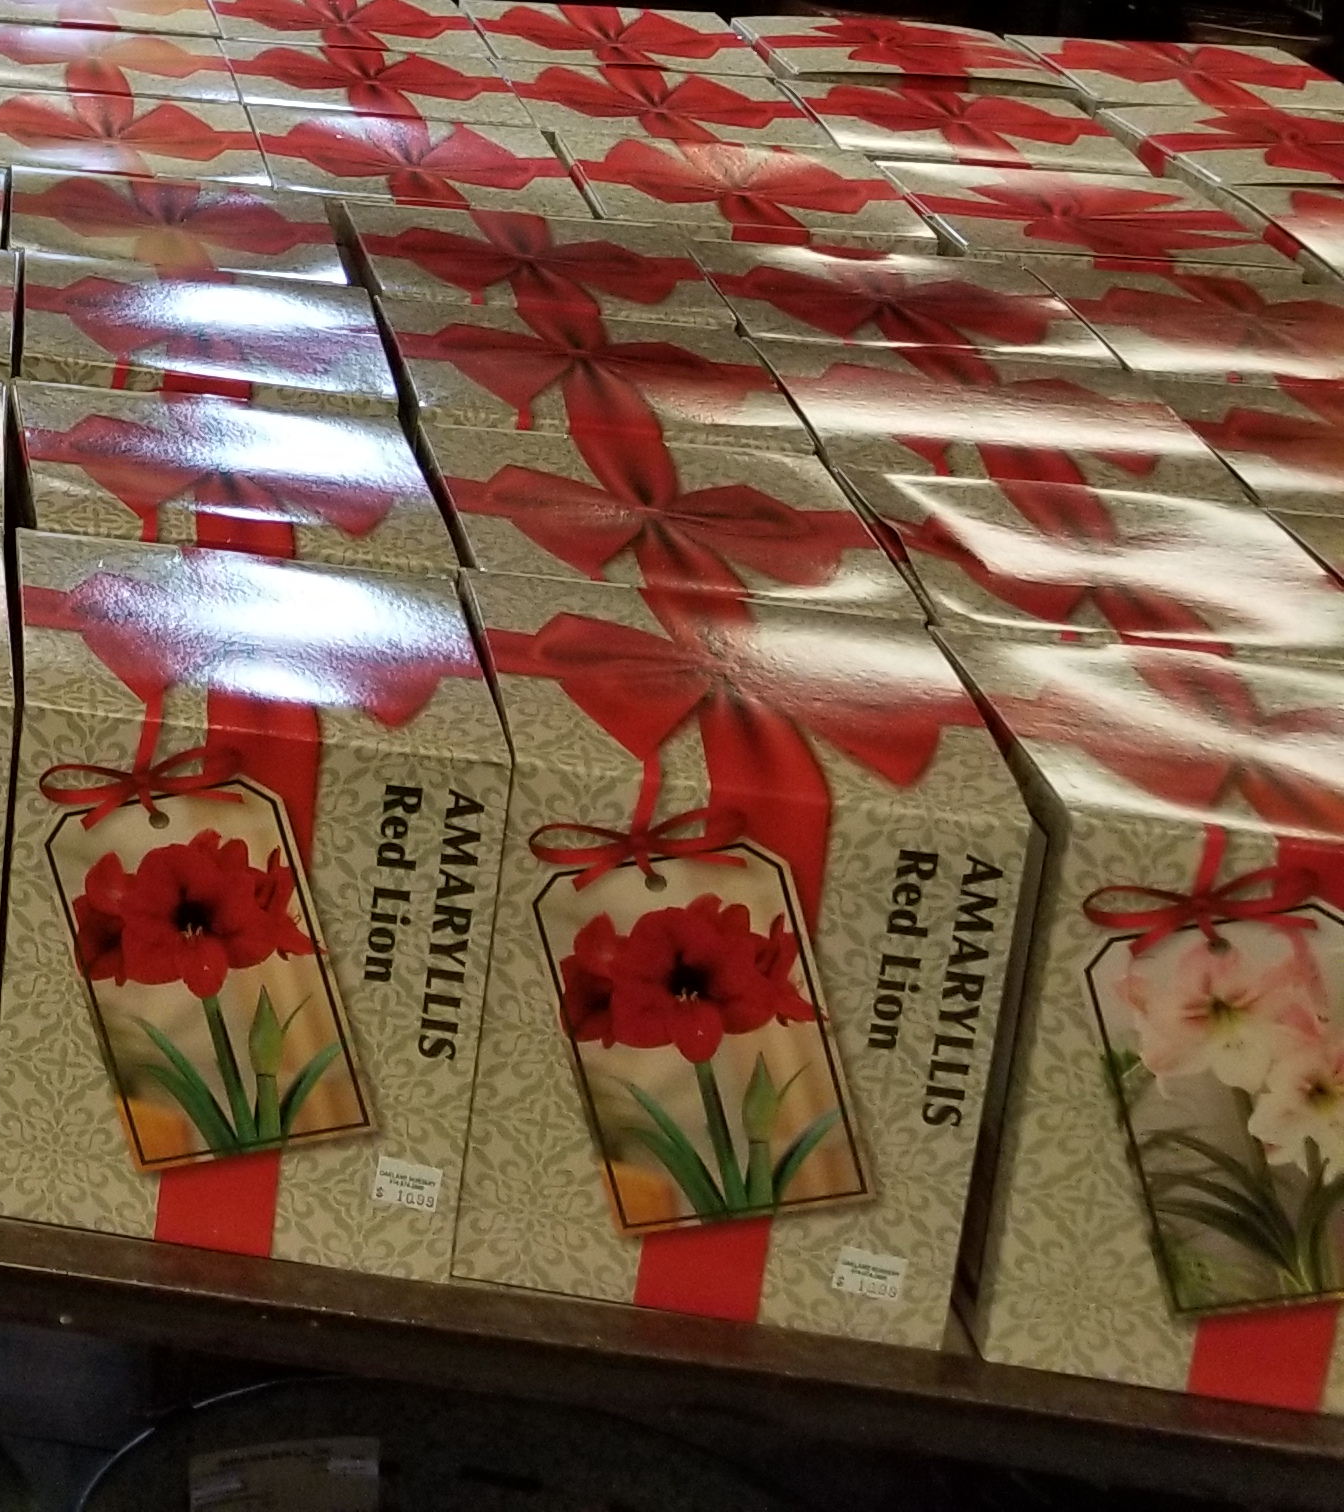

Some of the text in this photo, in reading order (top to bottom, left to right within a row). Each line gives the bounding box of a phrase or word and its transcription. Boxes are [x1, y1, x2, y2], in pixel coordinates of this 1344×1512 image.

[363, 784, 423, 983] Red Lion
[418, 788, 485, 1063] AMARYLLIS
[867, 848, 939, 1051] Red Lion
[922, 854, 1004, 1128] AMARYLLIS
